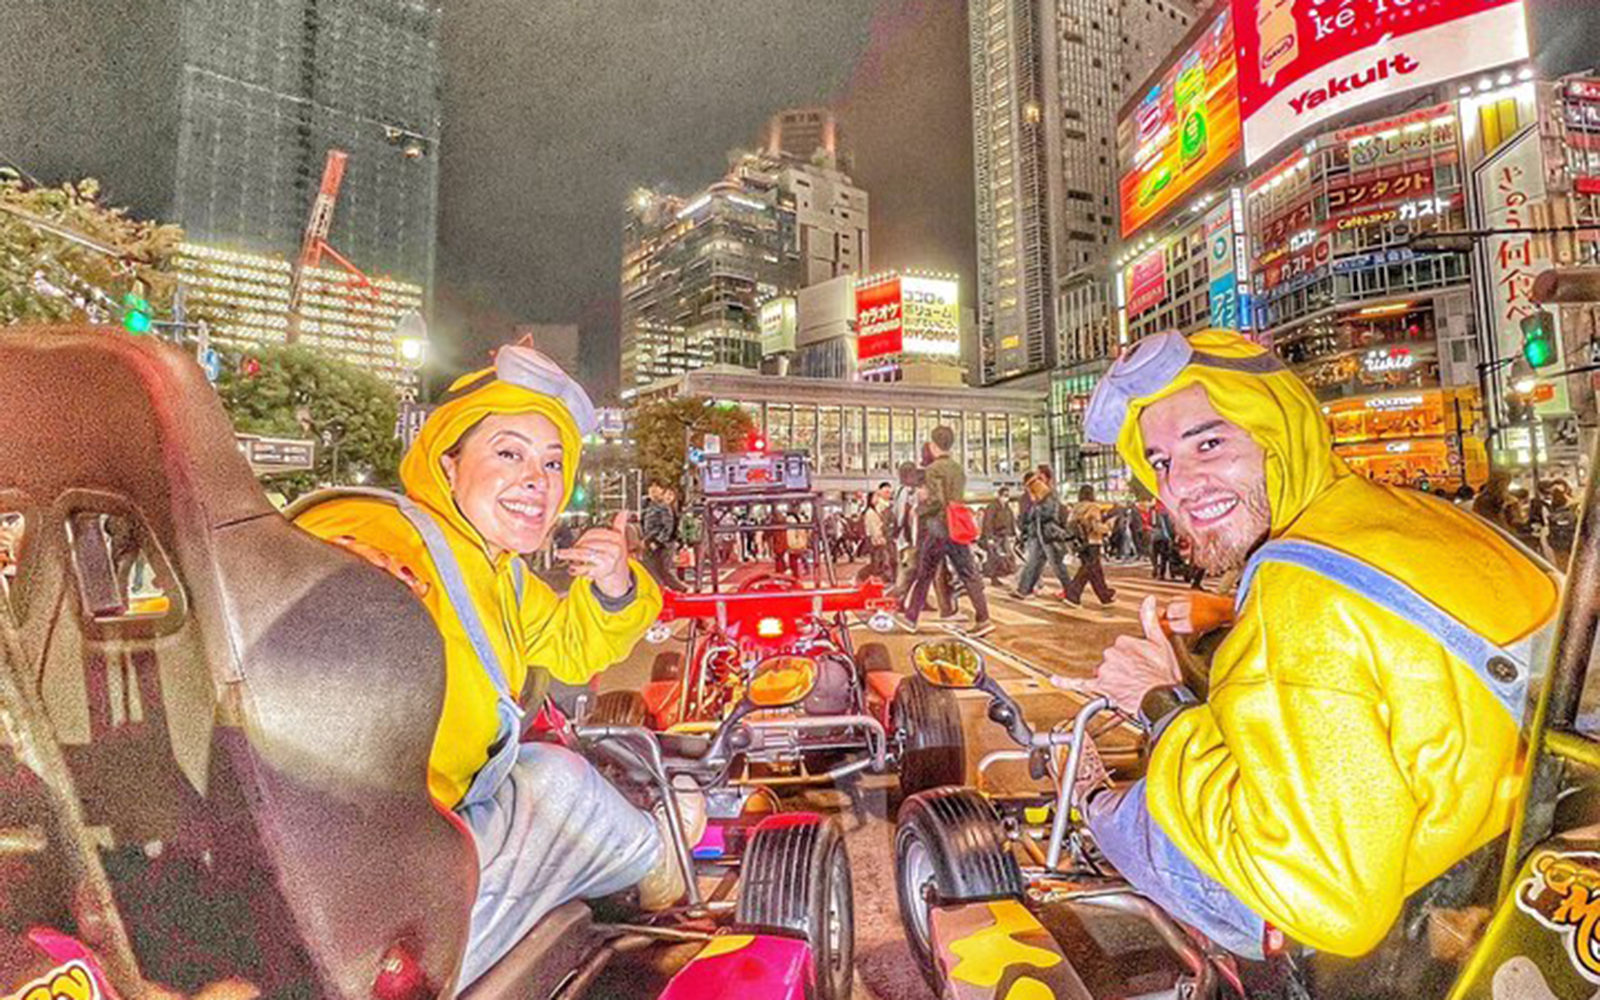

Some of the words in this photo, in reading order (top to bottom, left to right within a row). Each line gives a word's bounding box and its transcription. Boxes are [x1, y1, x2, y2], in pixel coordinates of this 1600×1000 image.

[1289, 53, 1419, 115] Yakult
[1329, 172, 1430, 207] コンタクト
[1400, 198, 1450, 220] ガスト
[859, 302, 899, 327] カラオケ
